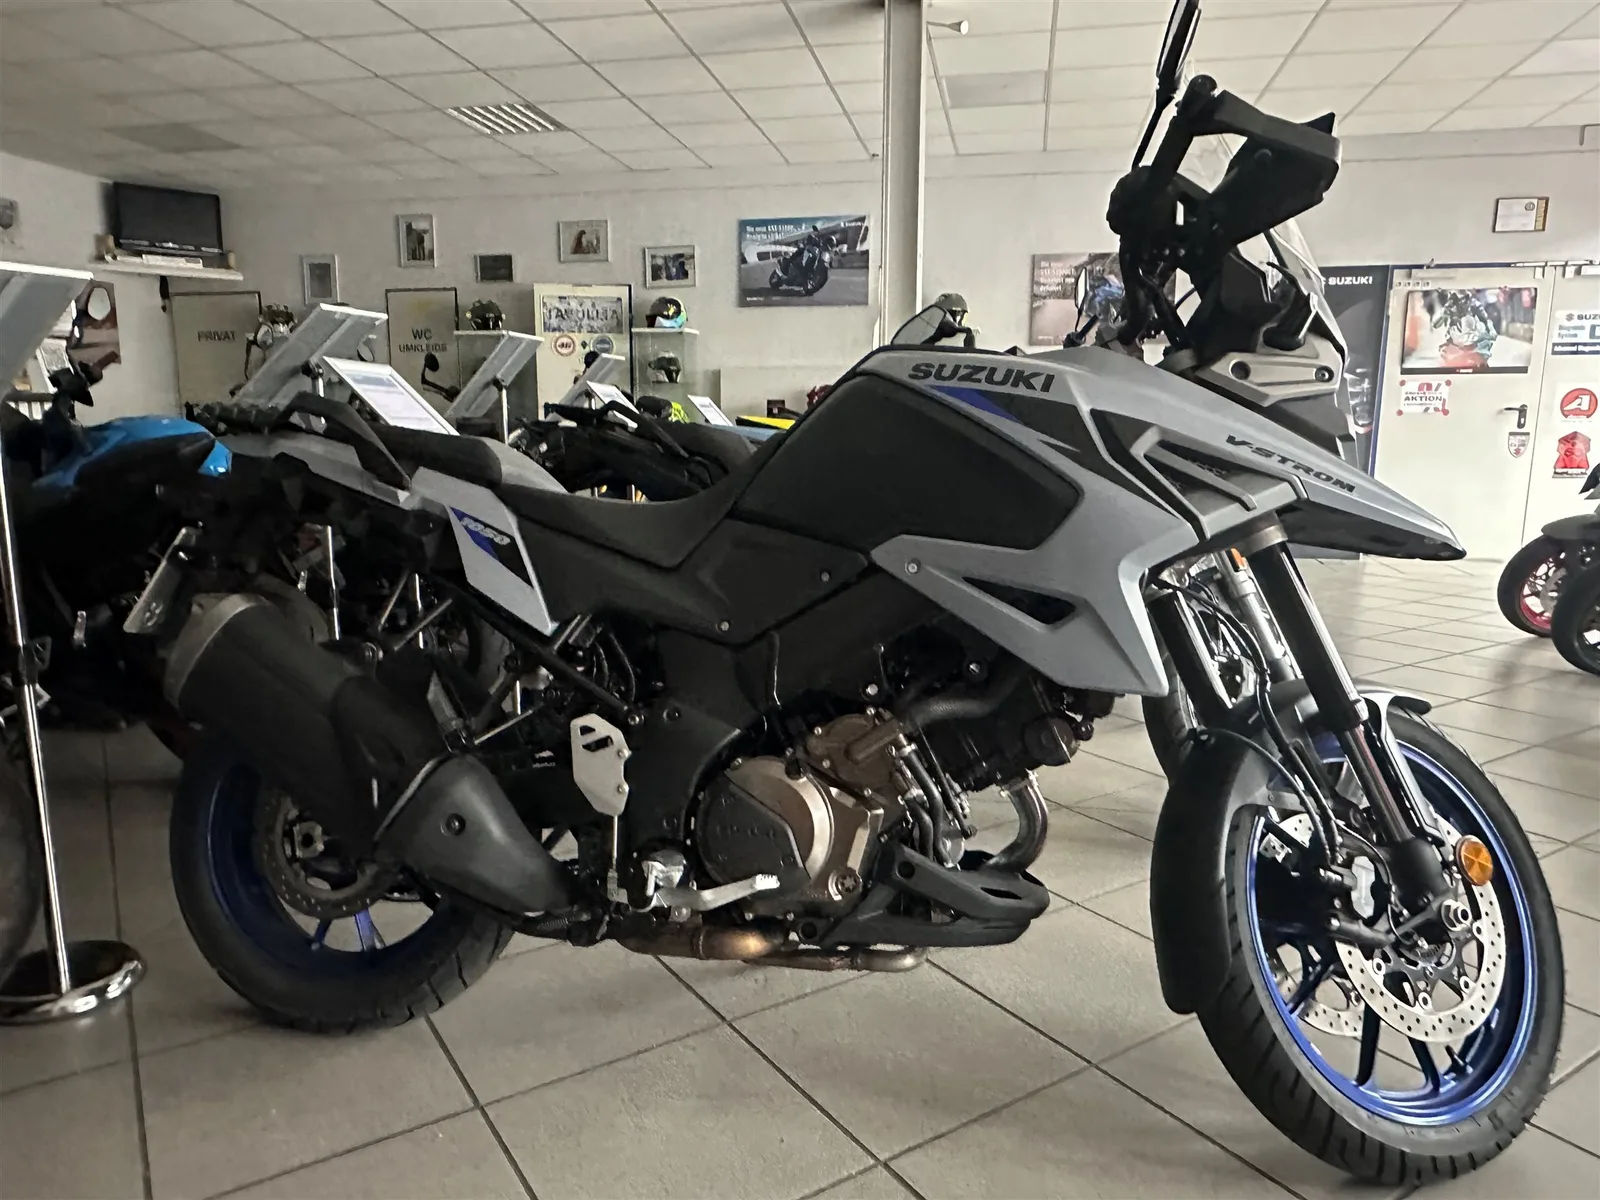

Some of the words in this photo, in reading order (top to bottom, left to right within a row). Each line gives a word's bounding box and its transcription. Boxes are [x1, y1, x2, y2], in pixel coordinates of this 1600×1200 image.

[1328, 276, 1373, 285] SUZUKI
[1577, 313, 1600, 321] SUZ
[197, 330, 236, 342] PRIVAT
[411, 328, 432, 341] WC
[908, 363, 1056, 393] SUZUKI
[1226, 434, 1356, 493] V-STROM
